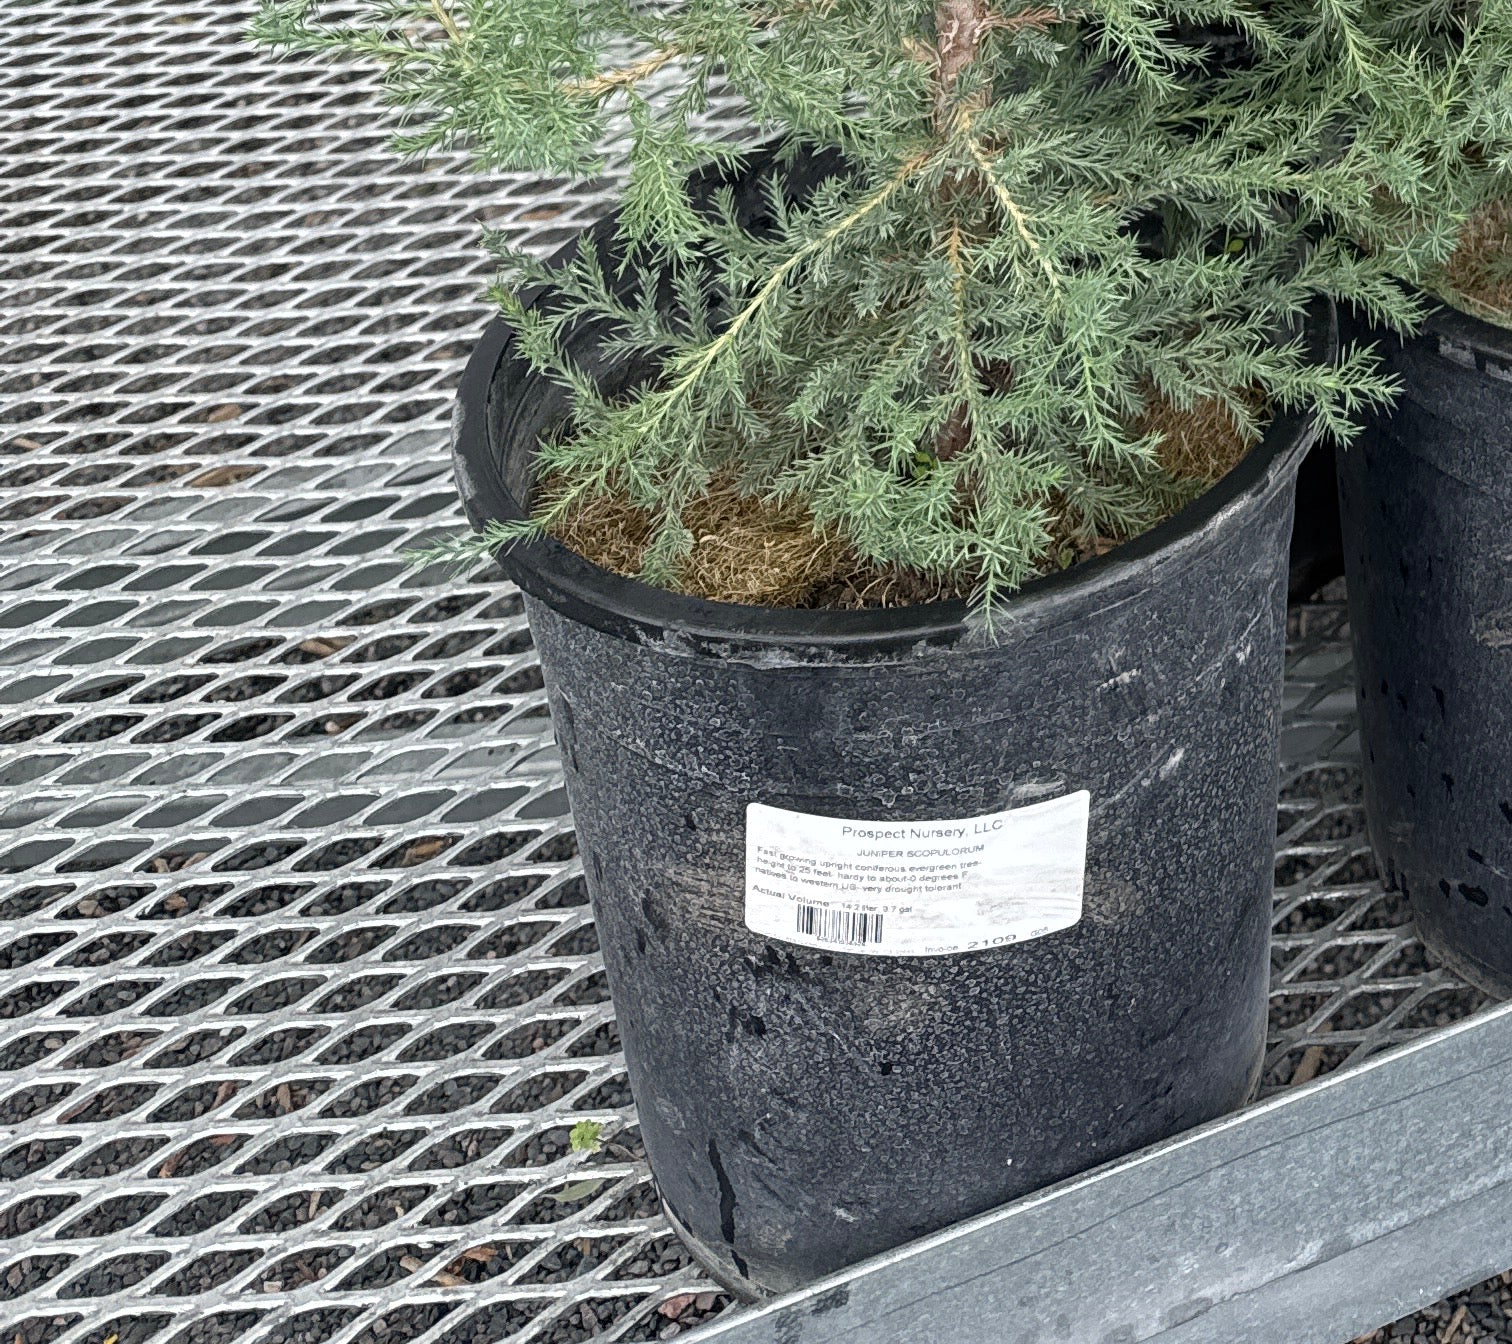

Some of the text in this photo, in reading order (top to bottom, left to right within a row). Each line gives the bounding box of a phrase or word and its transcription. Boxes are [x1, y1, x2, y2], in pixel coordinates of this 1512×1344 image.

[843, 826, 906, 840] Prospect
[974, 819, 1003, 834] LLC
[757, 845, 777, 857] Fast
[780, 853, 816, 866] growing
[820, 860, 853, 871] upright
[909, 863, 957, 873] evergreen
[857, 844, 985, 858] JUNIPER SCOPULORUM
[755, 867, 787, 879] natives
[801, 878, 838, 889] western
[862, 885, 882, 893] very
[885, 885, 922, 894] drought
[925, 882, 962, 892] tolerant
[757, 856, 785, 868] height
[837, 872, 865, 882] hardy
[919, 873, 959, 882] degrees
[752, 884, 785, 899] Actual
